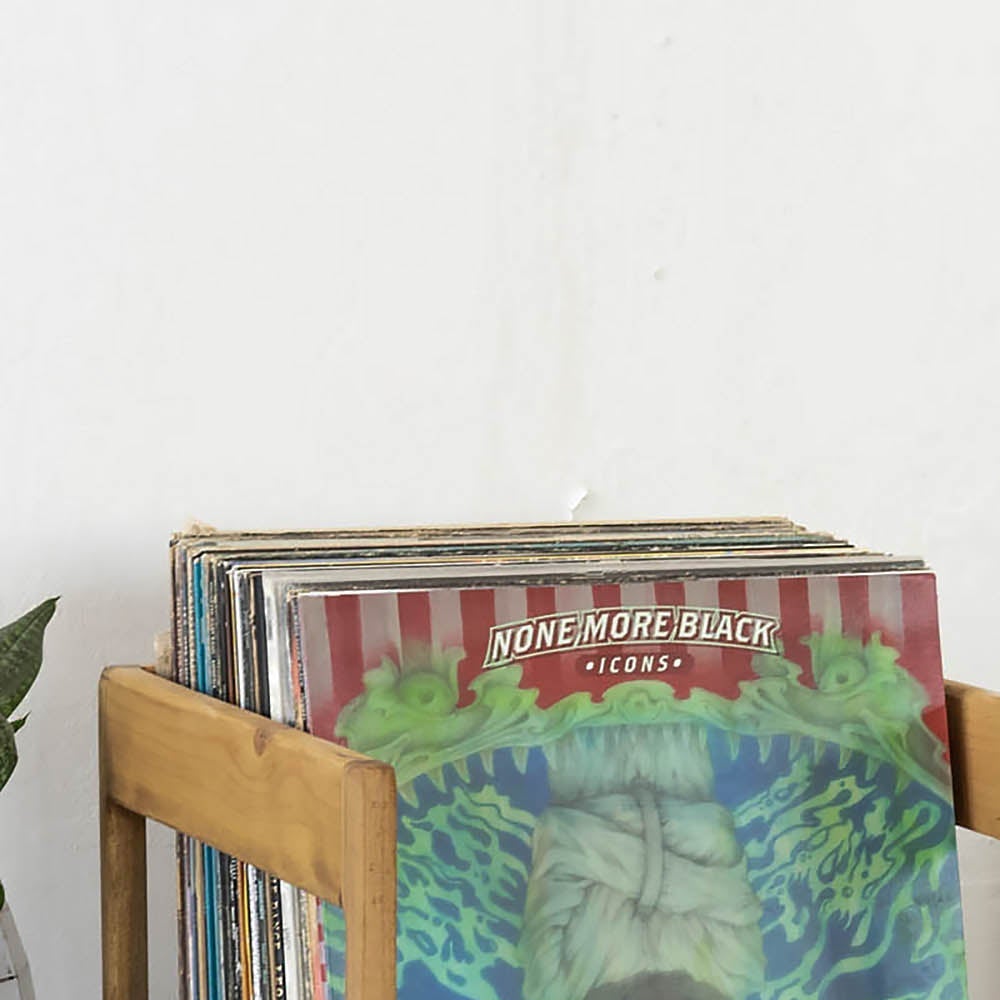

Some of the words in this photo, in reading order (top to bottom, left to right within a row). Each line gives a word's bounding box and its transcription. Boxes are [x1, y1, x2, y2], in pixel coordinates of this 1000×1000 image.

[492, 616, 580, 660] NONE
[583, 610, 672, 643] MORE
[674, 610, 777, 647] BLACK
